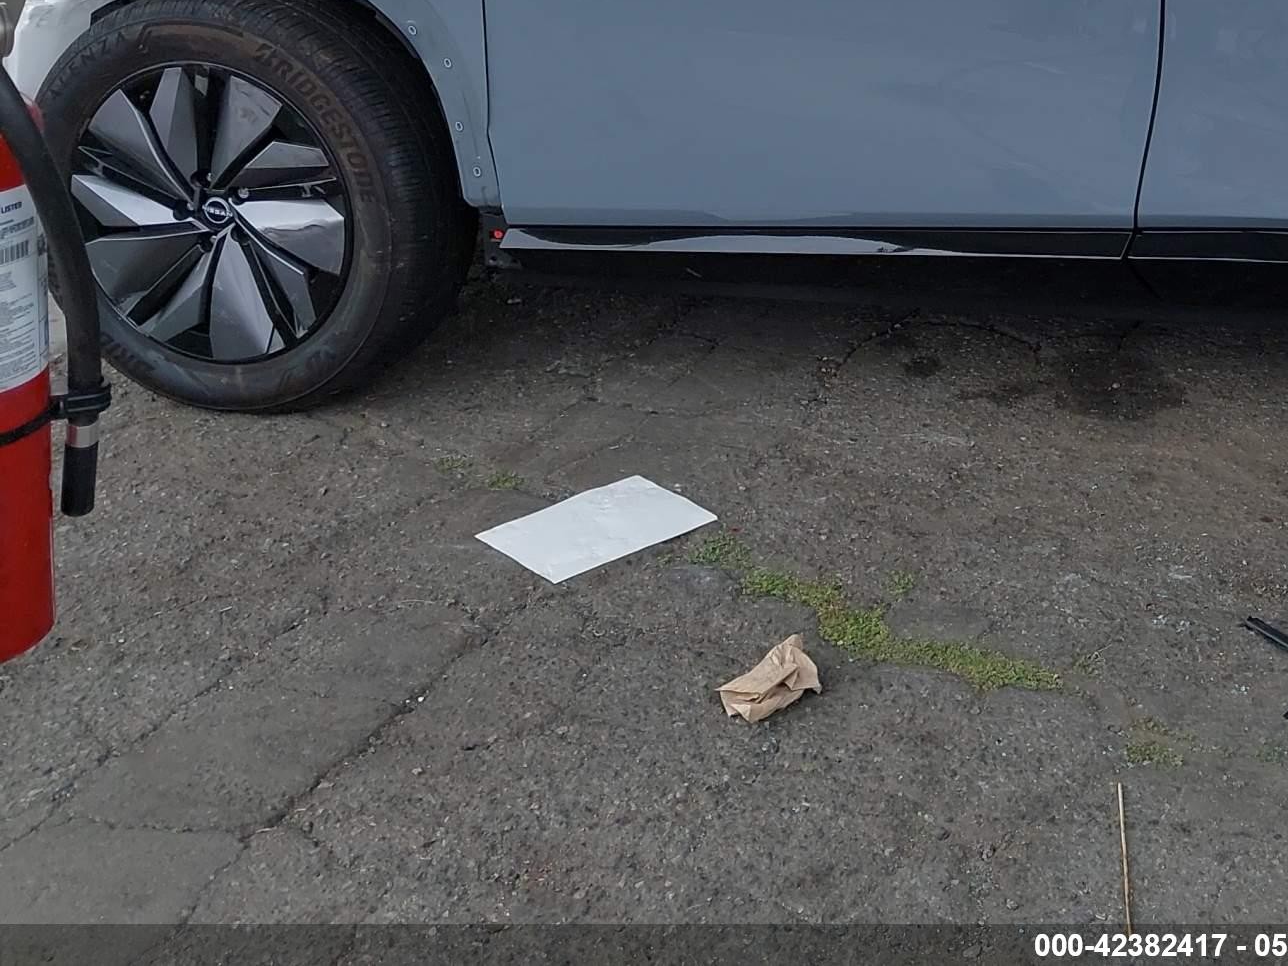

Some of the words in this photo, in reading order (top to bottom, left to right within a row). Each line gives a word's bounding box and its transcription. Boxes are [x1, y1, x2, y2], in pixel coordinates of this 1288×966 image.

[49, 31, 126, 98] ALENZA
[254, 42, 377, 203] BRIDGESTONE
[1, 201, 23, 214] LISTED
